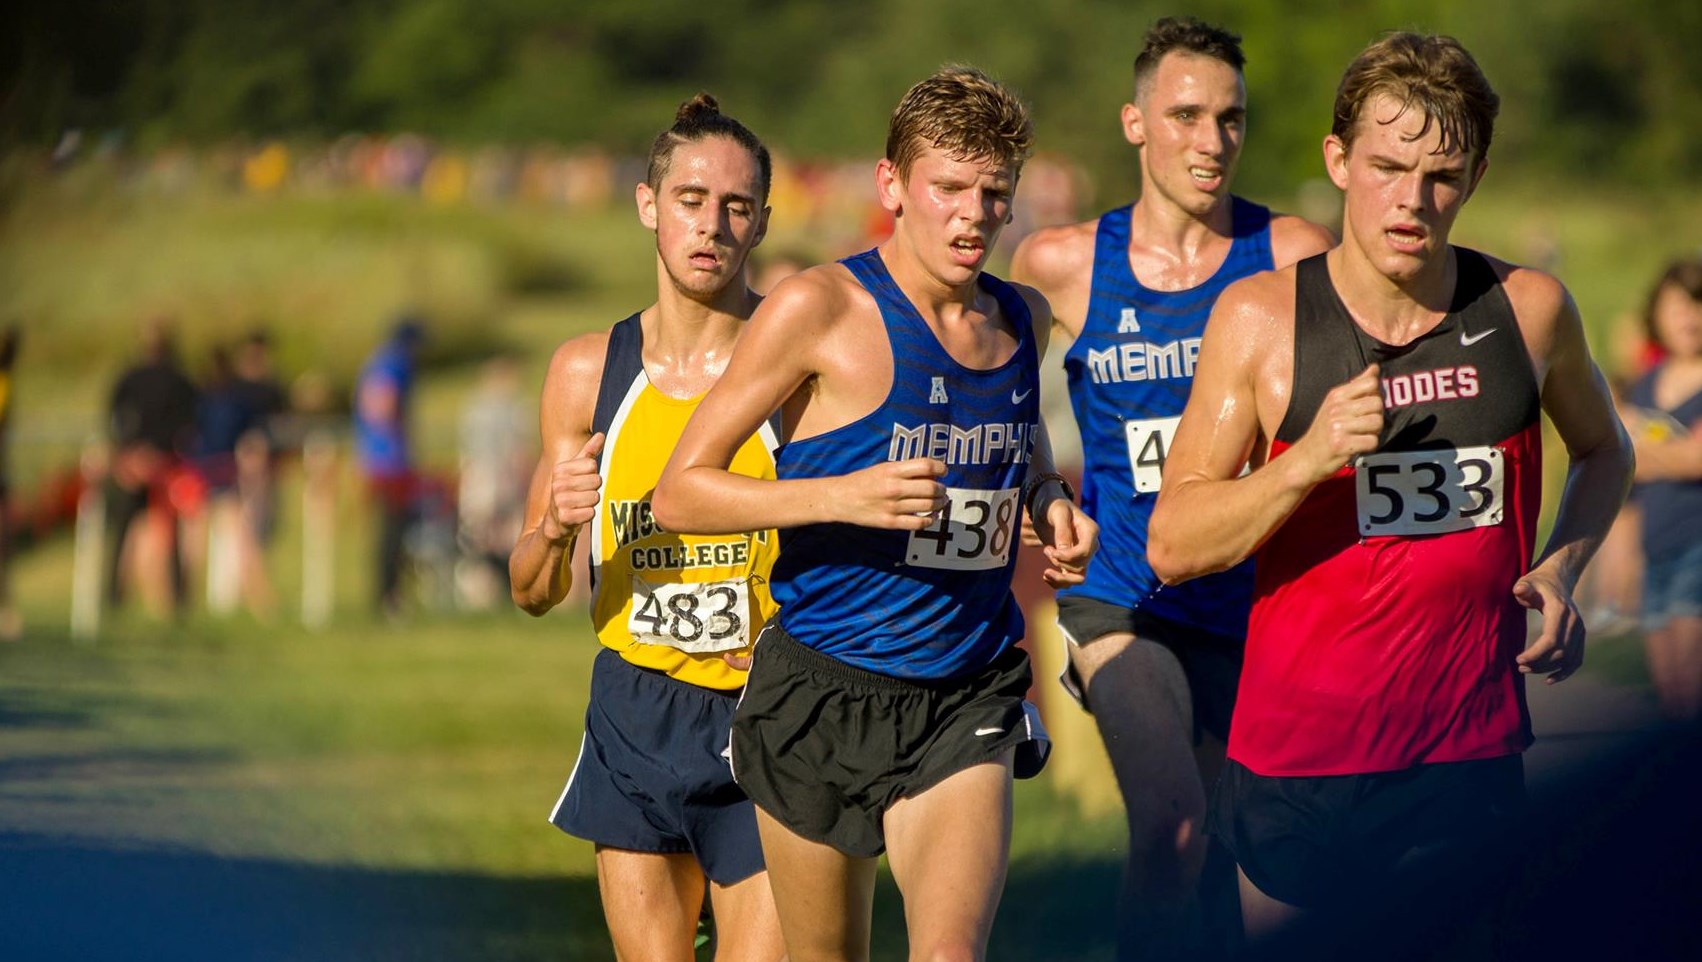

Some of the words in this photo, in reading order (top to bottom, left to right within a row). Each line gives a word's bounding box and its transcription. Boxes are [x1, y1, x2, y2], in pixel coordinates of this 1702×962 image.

[1088, 337, 1203, 384] MEMP
[1367, 458, 1494, 525] 533
[630, 541, 749, 571] COLLEGE
[914, 498, 1013, 560] 438
[634, 586, 742, 642] 483
